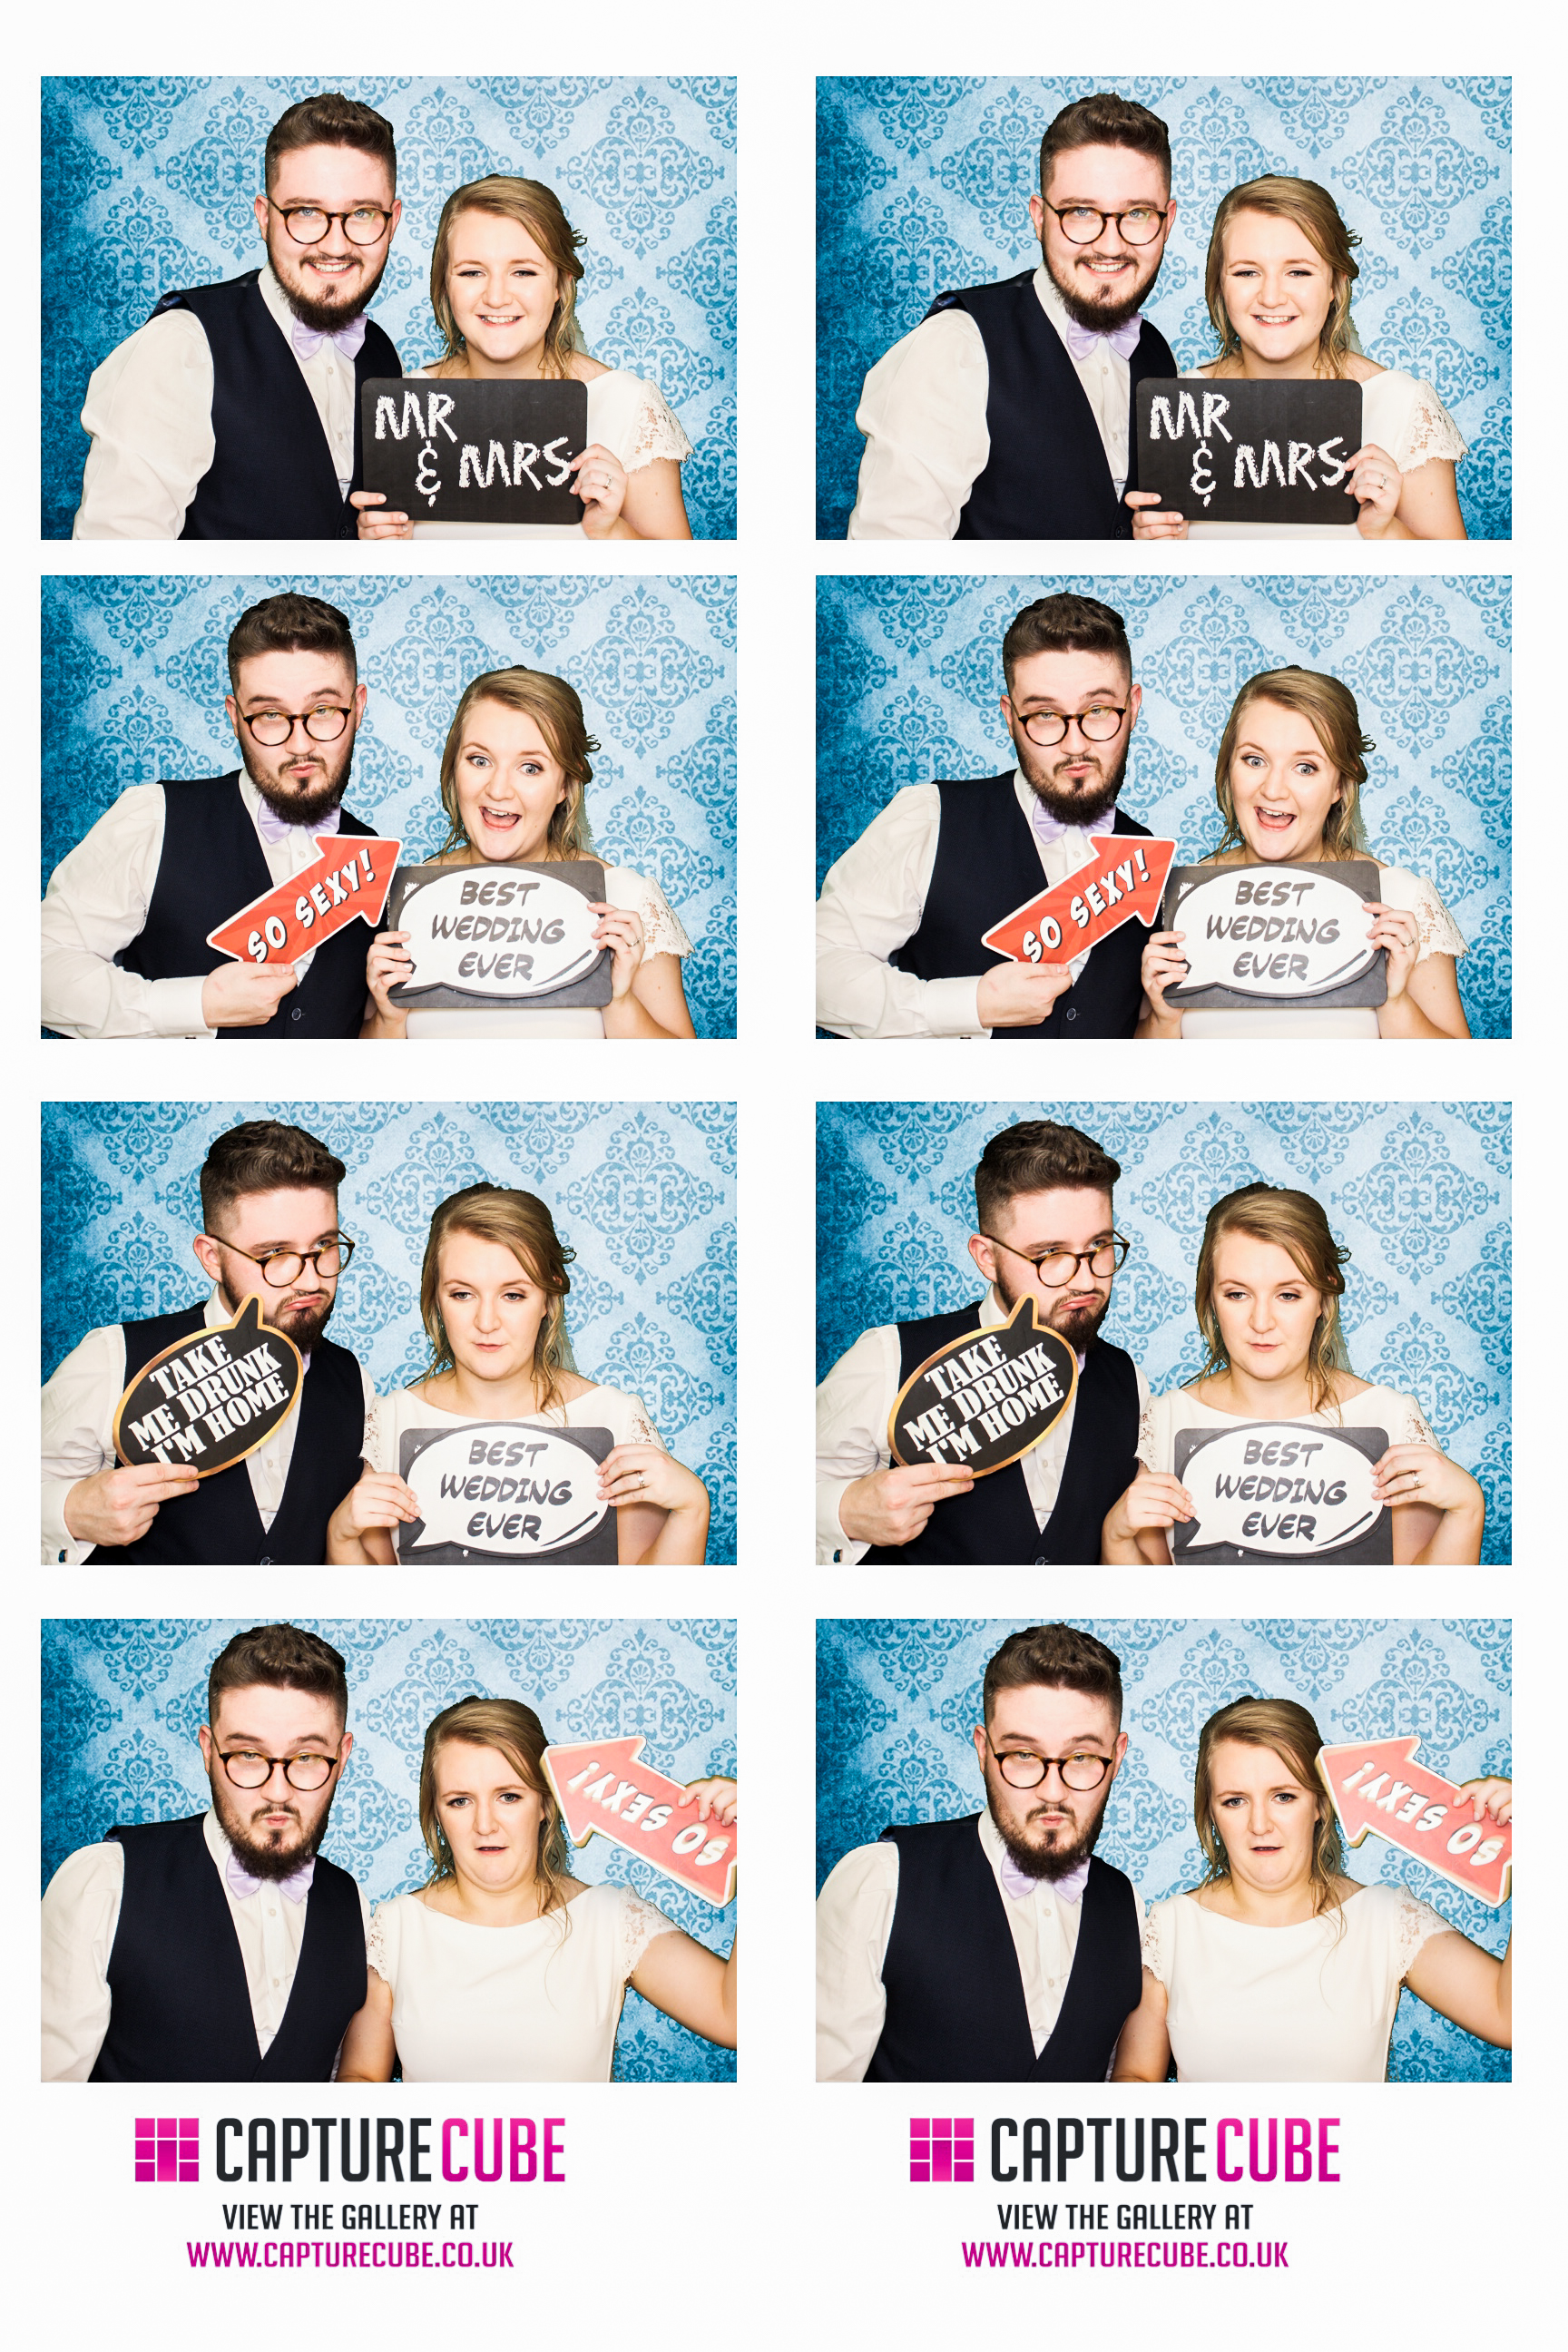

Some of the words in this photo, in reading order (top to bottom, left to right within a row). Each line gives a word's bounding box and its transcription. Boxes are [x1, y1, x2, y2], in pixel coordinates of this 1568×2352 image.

[375, 391, 458, 443] MR
[1150, 391, 1233, 443] MR
[459, 436, 573, 491] MRS
[1234, 436, 1348, 491] MRS
[247, 916, 288, 963] SO
[295, 848, 376, 929] SEXY!
[460, 880, 541, 906] BEST
[1022, 916, 1063, 963] SO
[1070, 848, 1151, 929] SEXY!
[1235, 880, 1316, 906] BEST
[432, 914, 565, 945] WEDDING
[1207, 914, 1340, 945] WEDDING
[458, 951, 534, 981] EVER
[1233, 951, 1309, 981] EVER
[149, 1335, 232, 1400] TAKE
[924, 1335, 1007, 1400] TAKE
[128, 1404, 181, 1452] ME
[176, 1342, 282, 1422] DRUNK
[202, 1373, 289, 1443] HOME
[903, 1404, 956, 1452] ME
[951, 1342, 1057, 1422] DRUNK
[977, 1373, 1064, 1443] HOME
[468, 1439, 549, 1467] BEST
[1243, 1439, 1324, 1467] BEST
[440, 1474, 573, 1506] WEDDING
[1215, 1474, 1348, 1506] WEDDING
[466, 1511, 543, 1542] EVER
[1241, 1511, 1318, 1542] EVER
[566, 1761, 674, 1832] SEXY!
[1341, 1761, 1449, 1832] SEXY!
[671, 1821, 731, 1866] SO
[1446, 1821, 1506, 1866] SO
